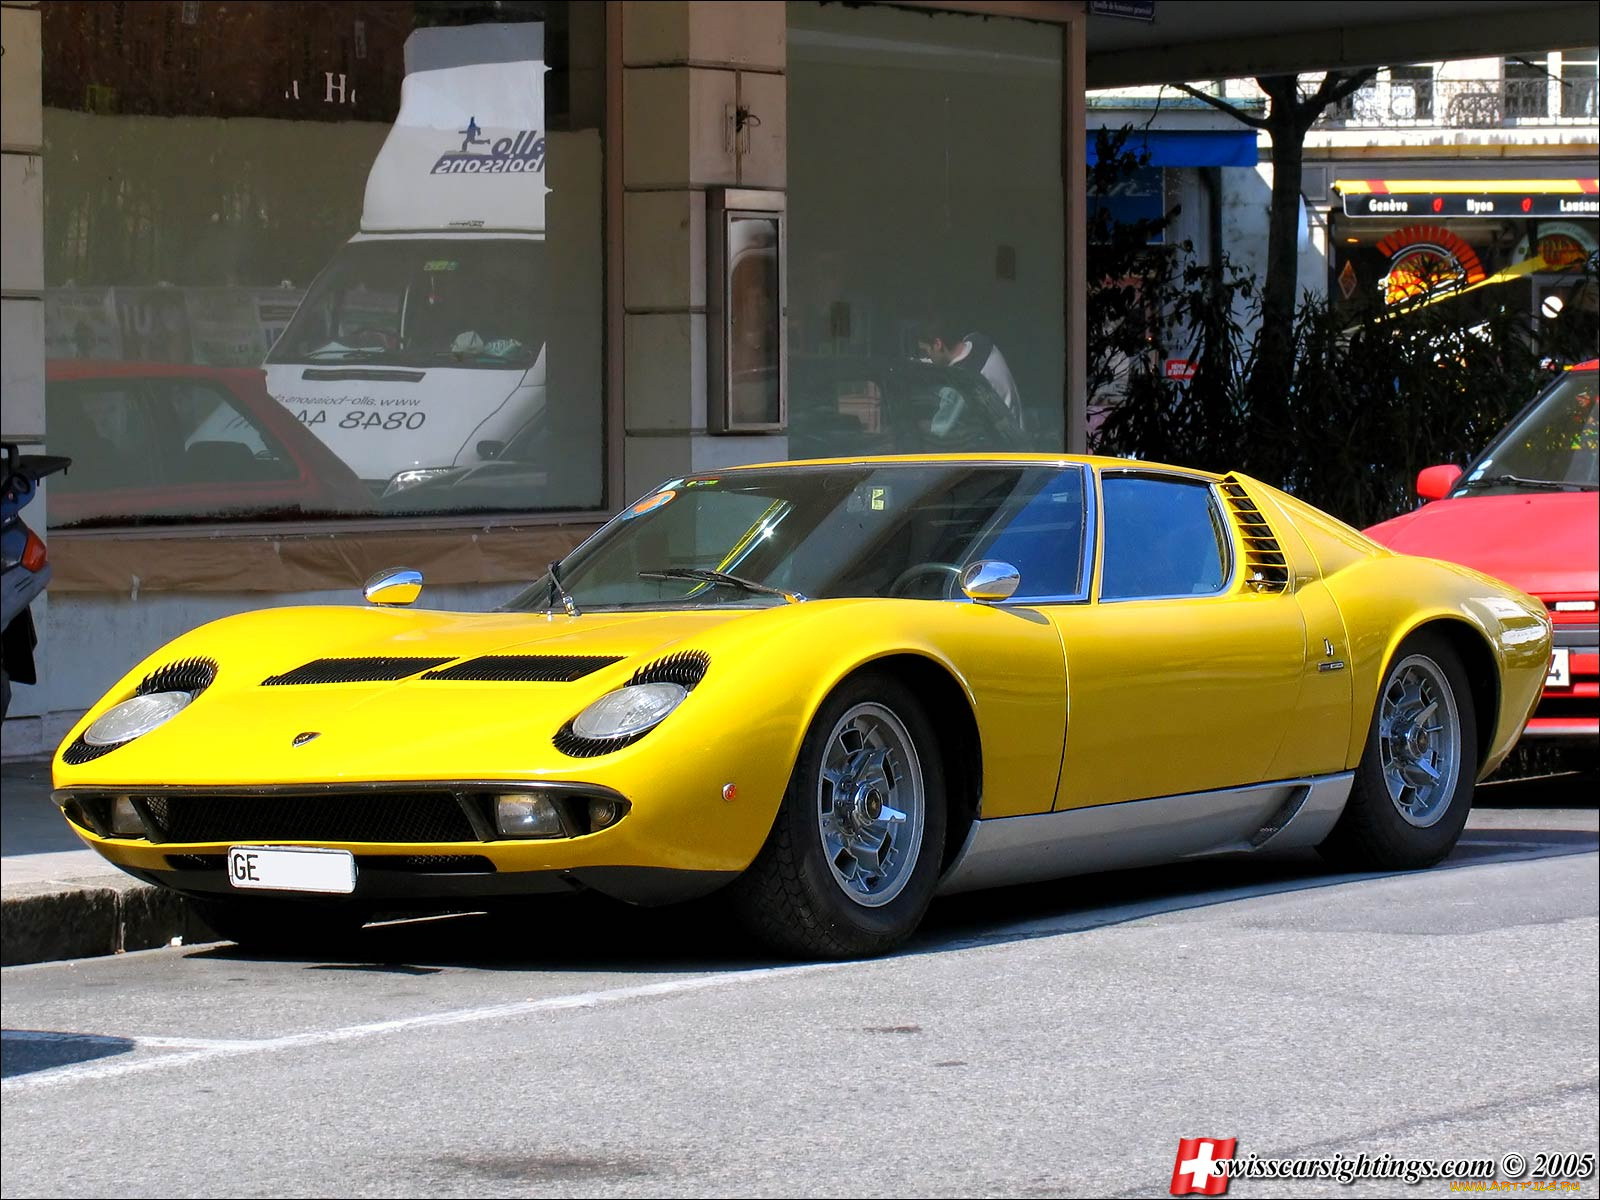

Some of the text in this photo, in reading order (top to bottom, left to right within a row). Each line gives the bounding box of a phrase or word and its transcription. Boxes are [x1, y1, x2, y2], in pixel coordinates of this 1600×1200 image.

[1369, 198, 1408, 212] Genève
[1466, 198, 1494, 214] Nyon
[233, 853, 260, 882] GE
